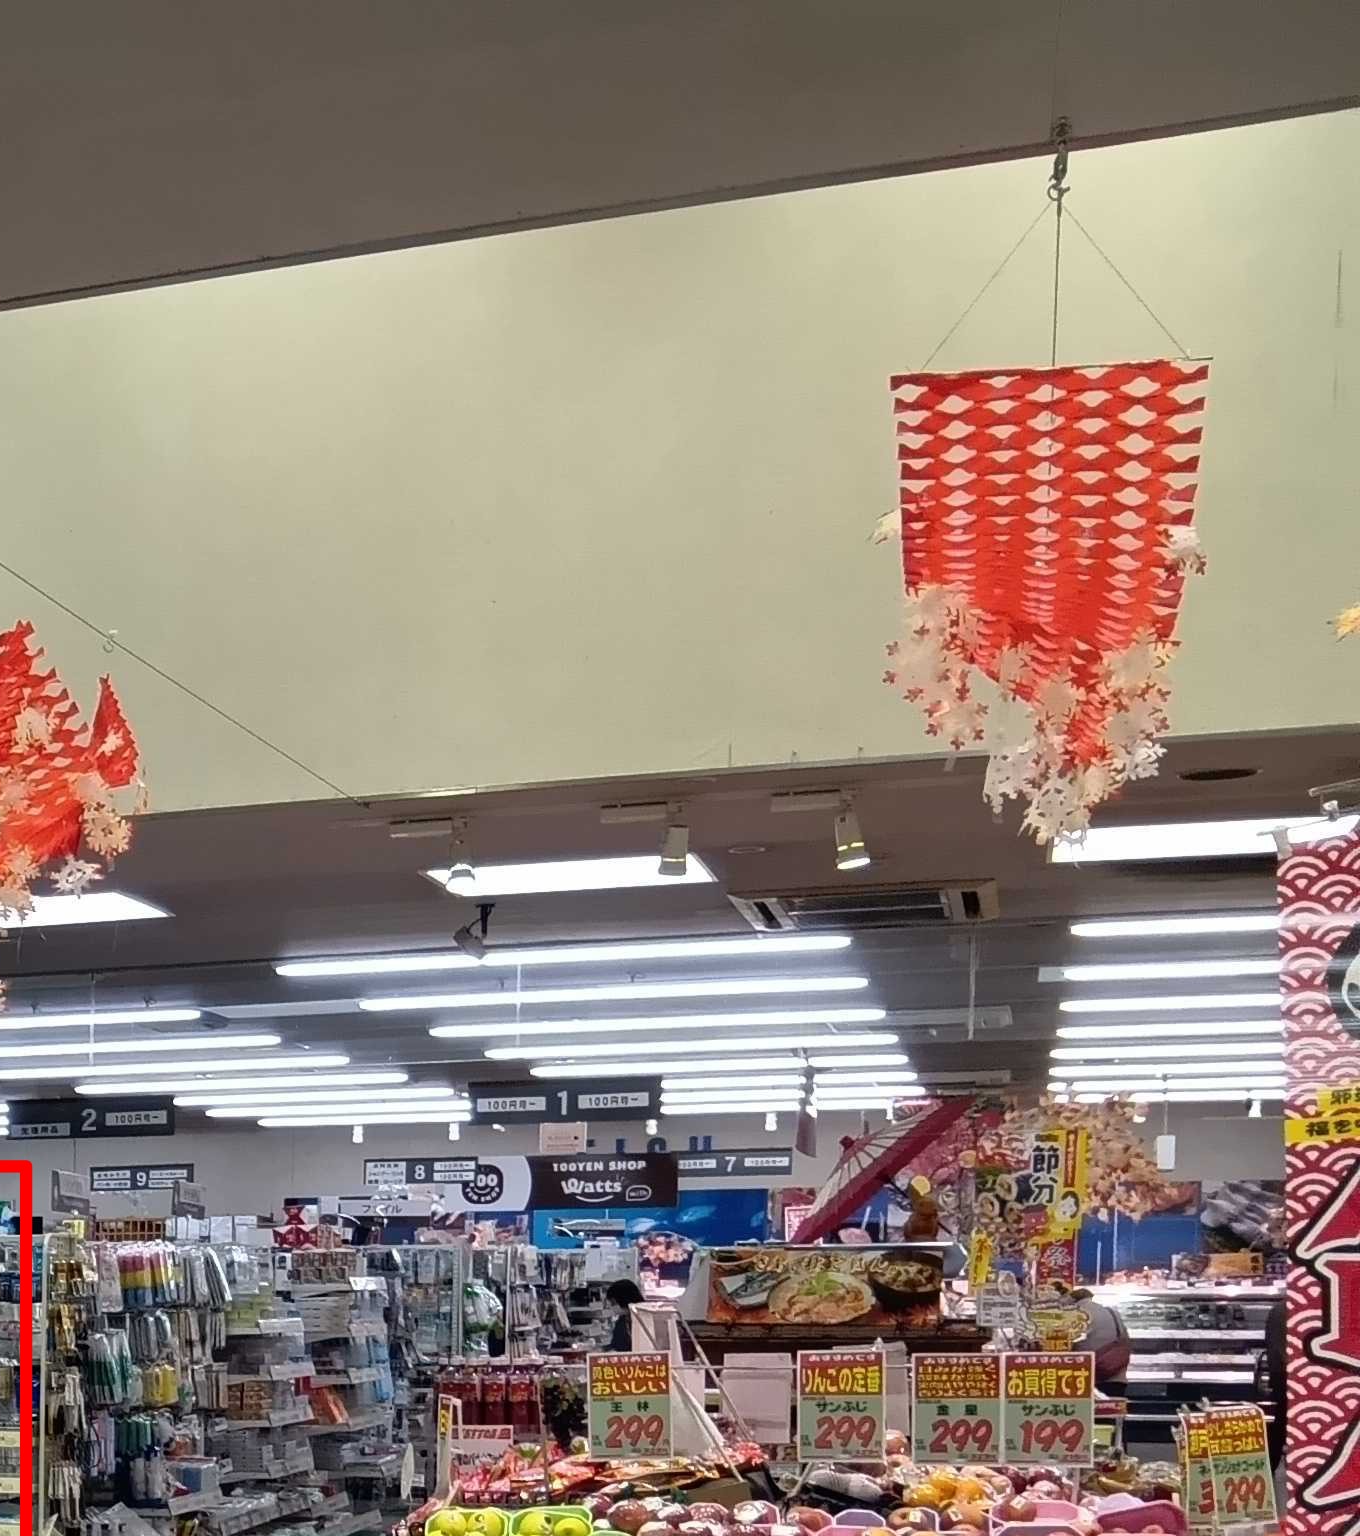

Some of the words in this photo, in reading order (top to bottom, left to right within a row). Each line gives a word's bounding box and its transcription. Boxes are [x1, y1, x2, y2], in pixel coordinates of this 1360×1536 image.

[556, 1090, 567, 1116] 1
[81, 1108, 96, 1131] 2
[413, 1165, 425, 1180] 8
[552, 1161, 604, 1173] 100YEN
[608, 1159, 647, 1171] SHOP
[725, 1157, 736, 1173] 7
[1031, 1145, 1059, 1206] 節分
[136, 1172, 146, 1185] 9
[591, 1380, 665, 1396] おいしい
[1007, 1368, 1090, 1397] お買得です
[815, 1401, 867, 1414] サンふじ
[1021, 1403, 1076, 1416] サンふじ
[605, 1415, 664, 1448] 299
[815, 1415, 877, 1449] 299
[929, 1418, 993, 1452] 299
[1019, 1420, 1085, 1453] 199
[1223, 1474, 1266, 1513] 299
